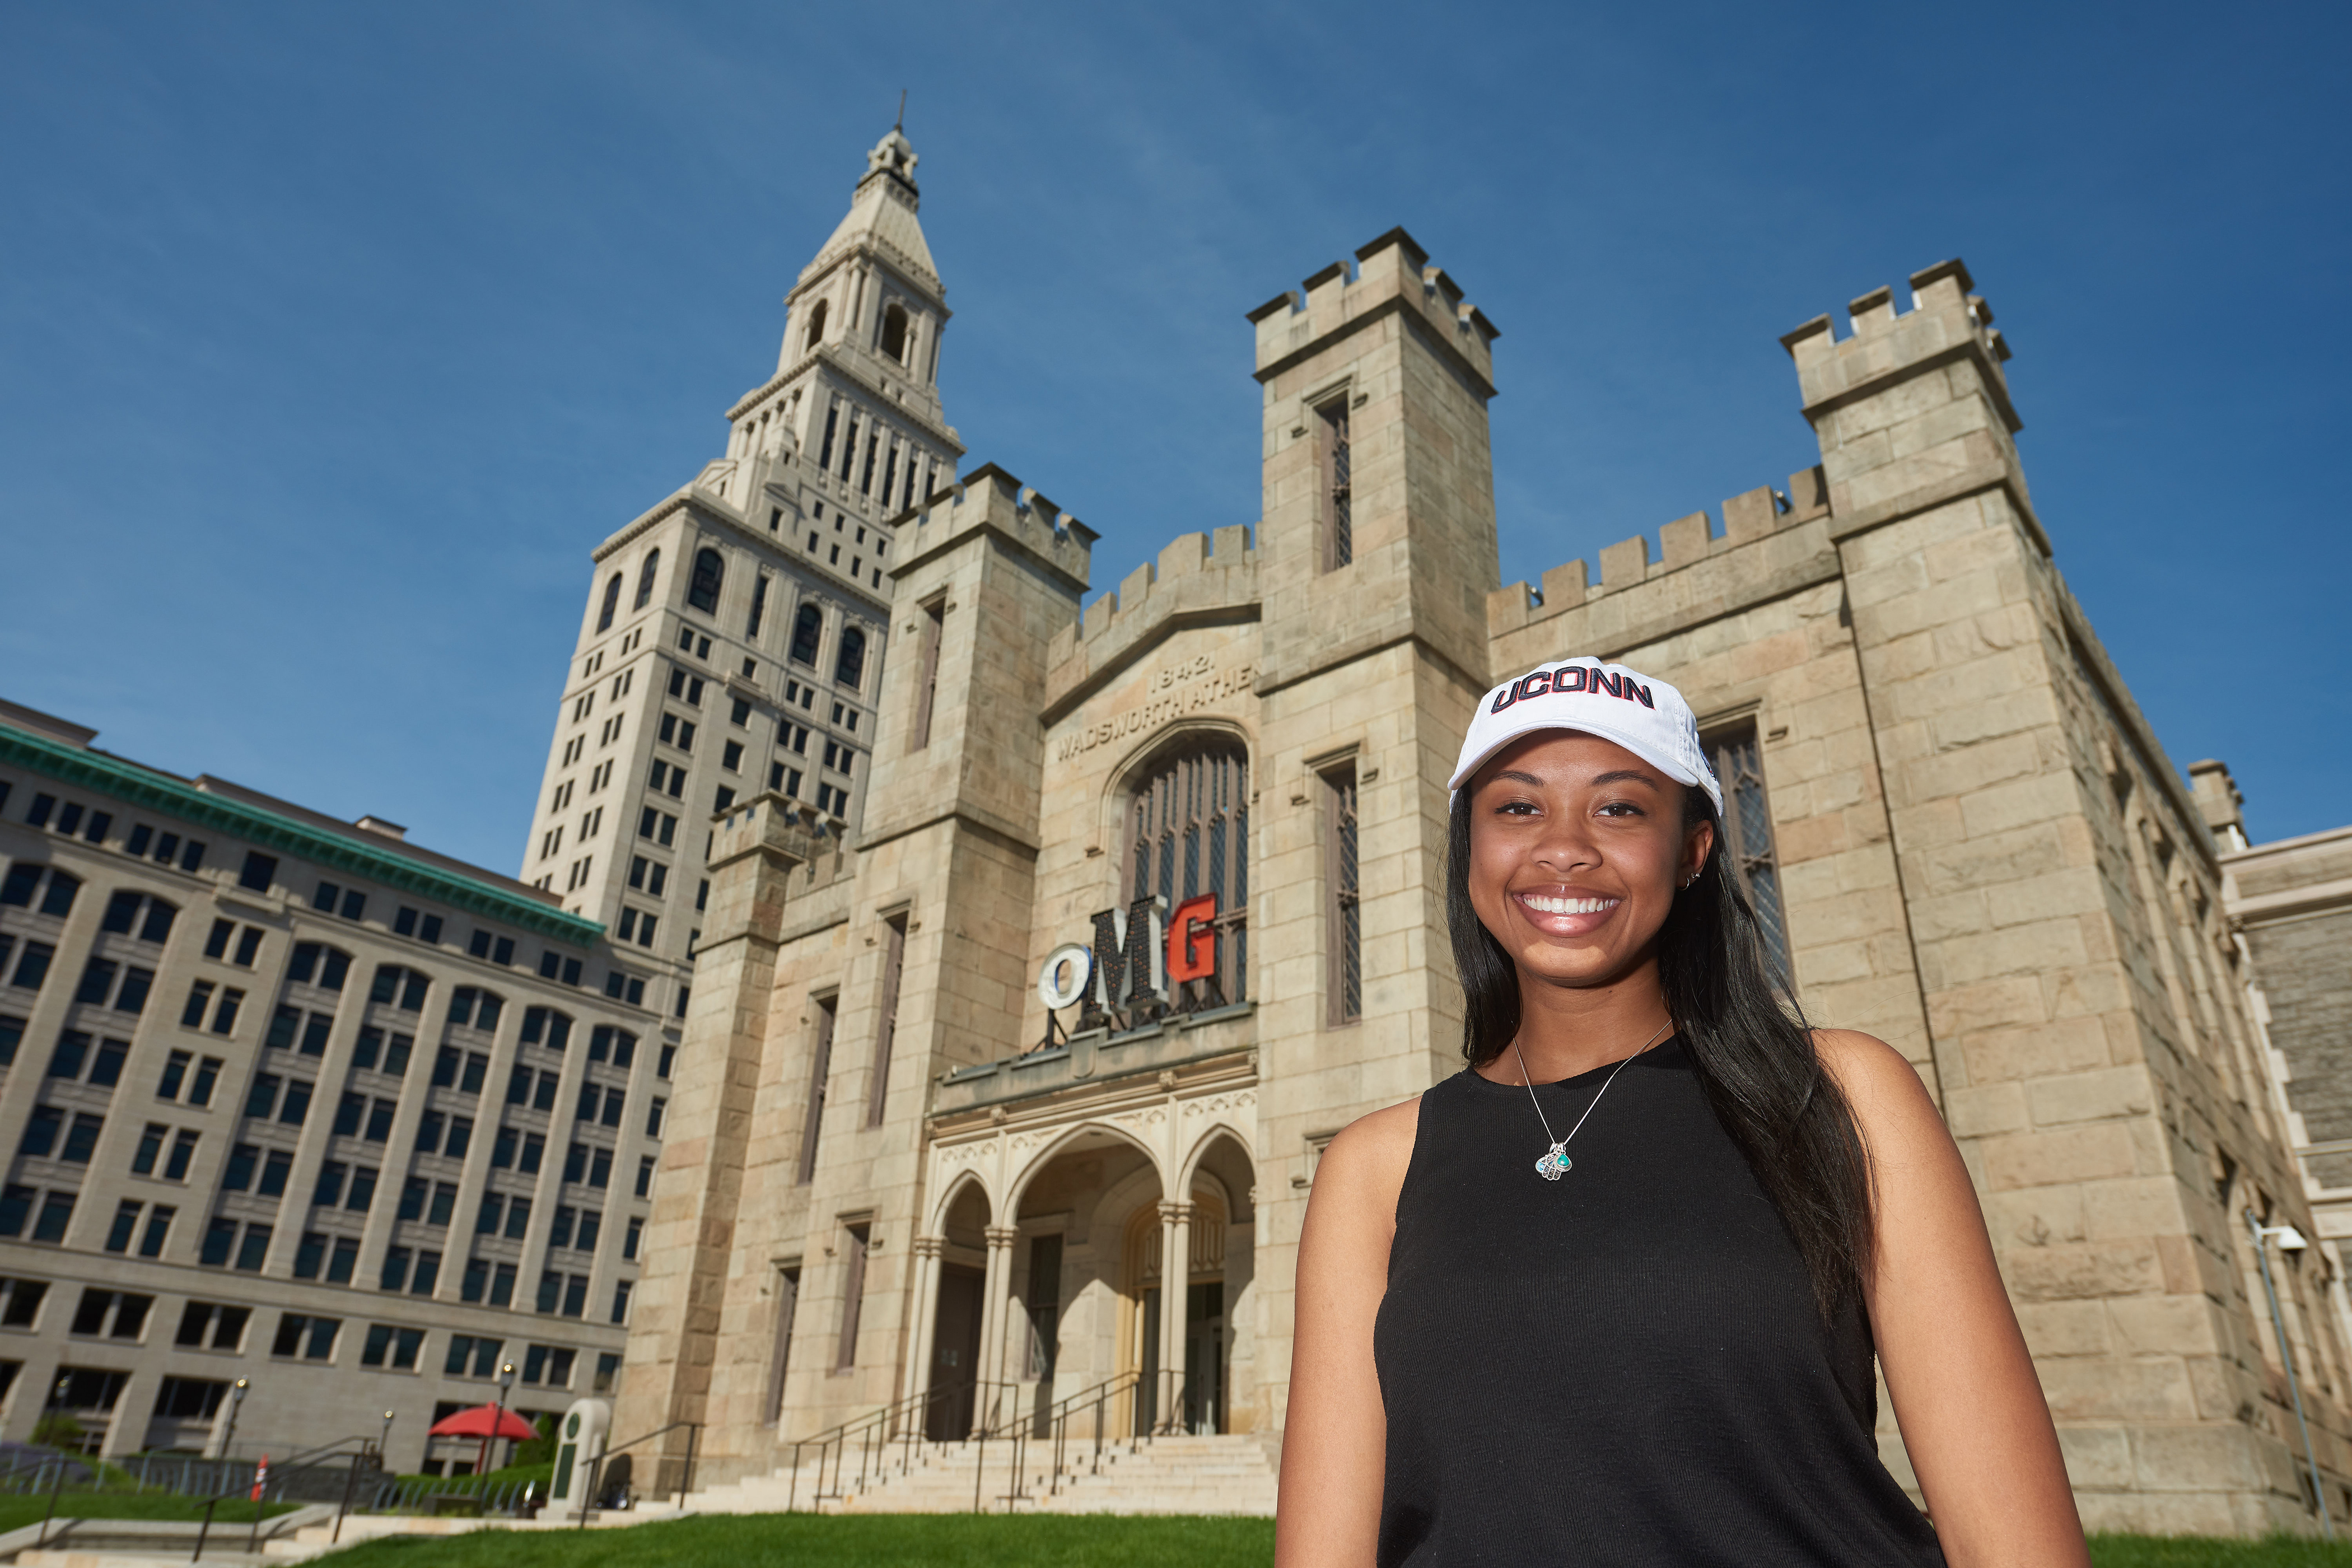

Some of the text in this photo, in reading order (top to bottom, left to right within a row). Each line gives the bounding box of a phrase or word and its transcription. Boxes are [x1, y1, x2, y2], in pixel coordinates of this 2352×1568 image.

[1491, 666, 1655, 715] UCONN
[1058, 691, 1185, 762] WADSWORTH
[1038, 892, 1217, 1019] OMG
